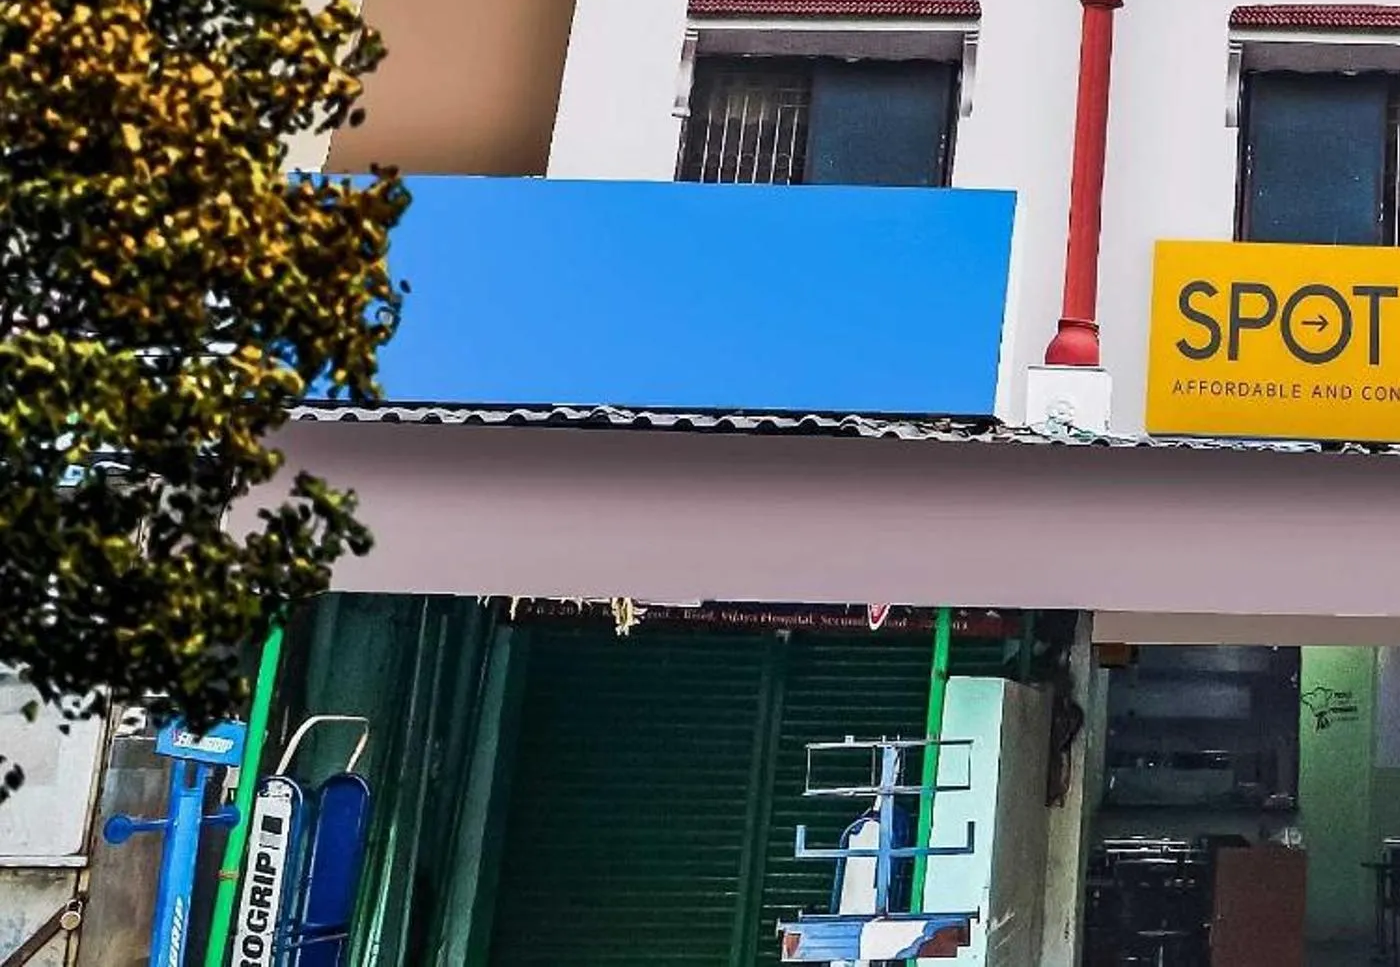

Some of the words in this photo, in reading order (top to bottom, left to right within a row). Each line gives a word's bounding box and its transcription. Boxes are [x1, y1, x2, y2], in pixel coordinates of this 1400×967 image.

[1176, 280, 1399, 366] SPOT
[1172, 379, 1301, 400] AFFORDABLE
[1311, 383, 1352, 401] AND
